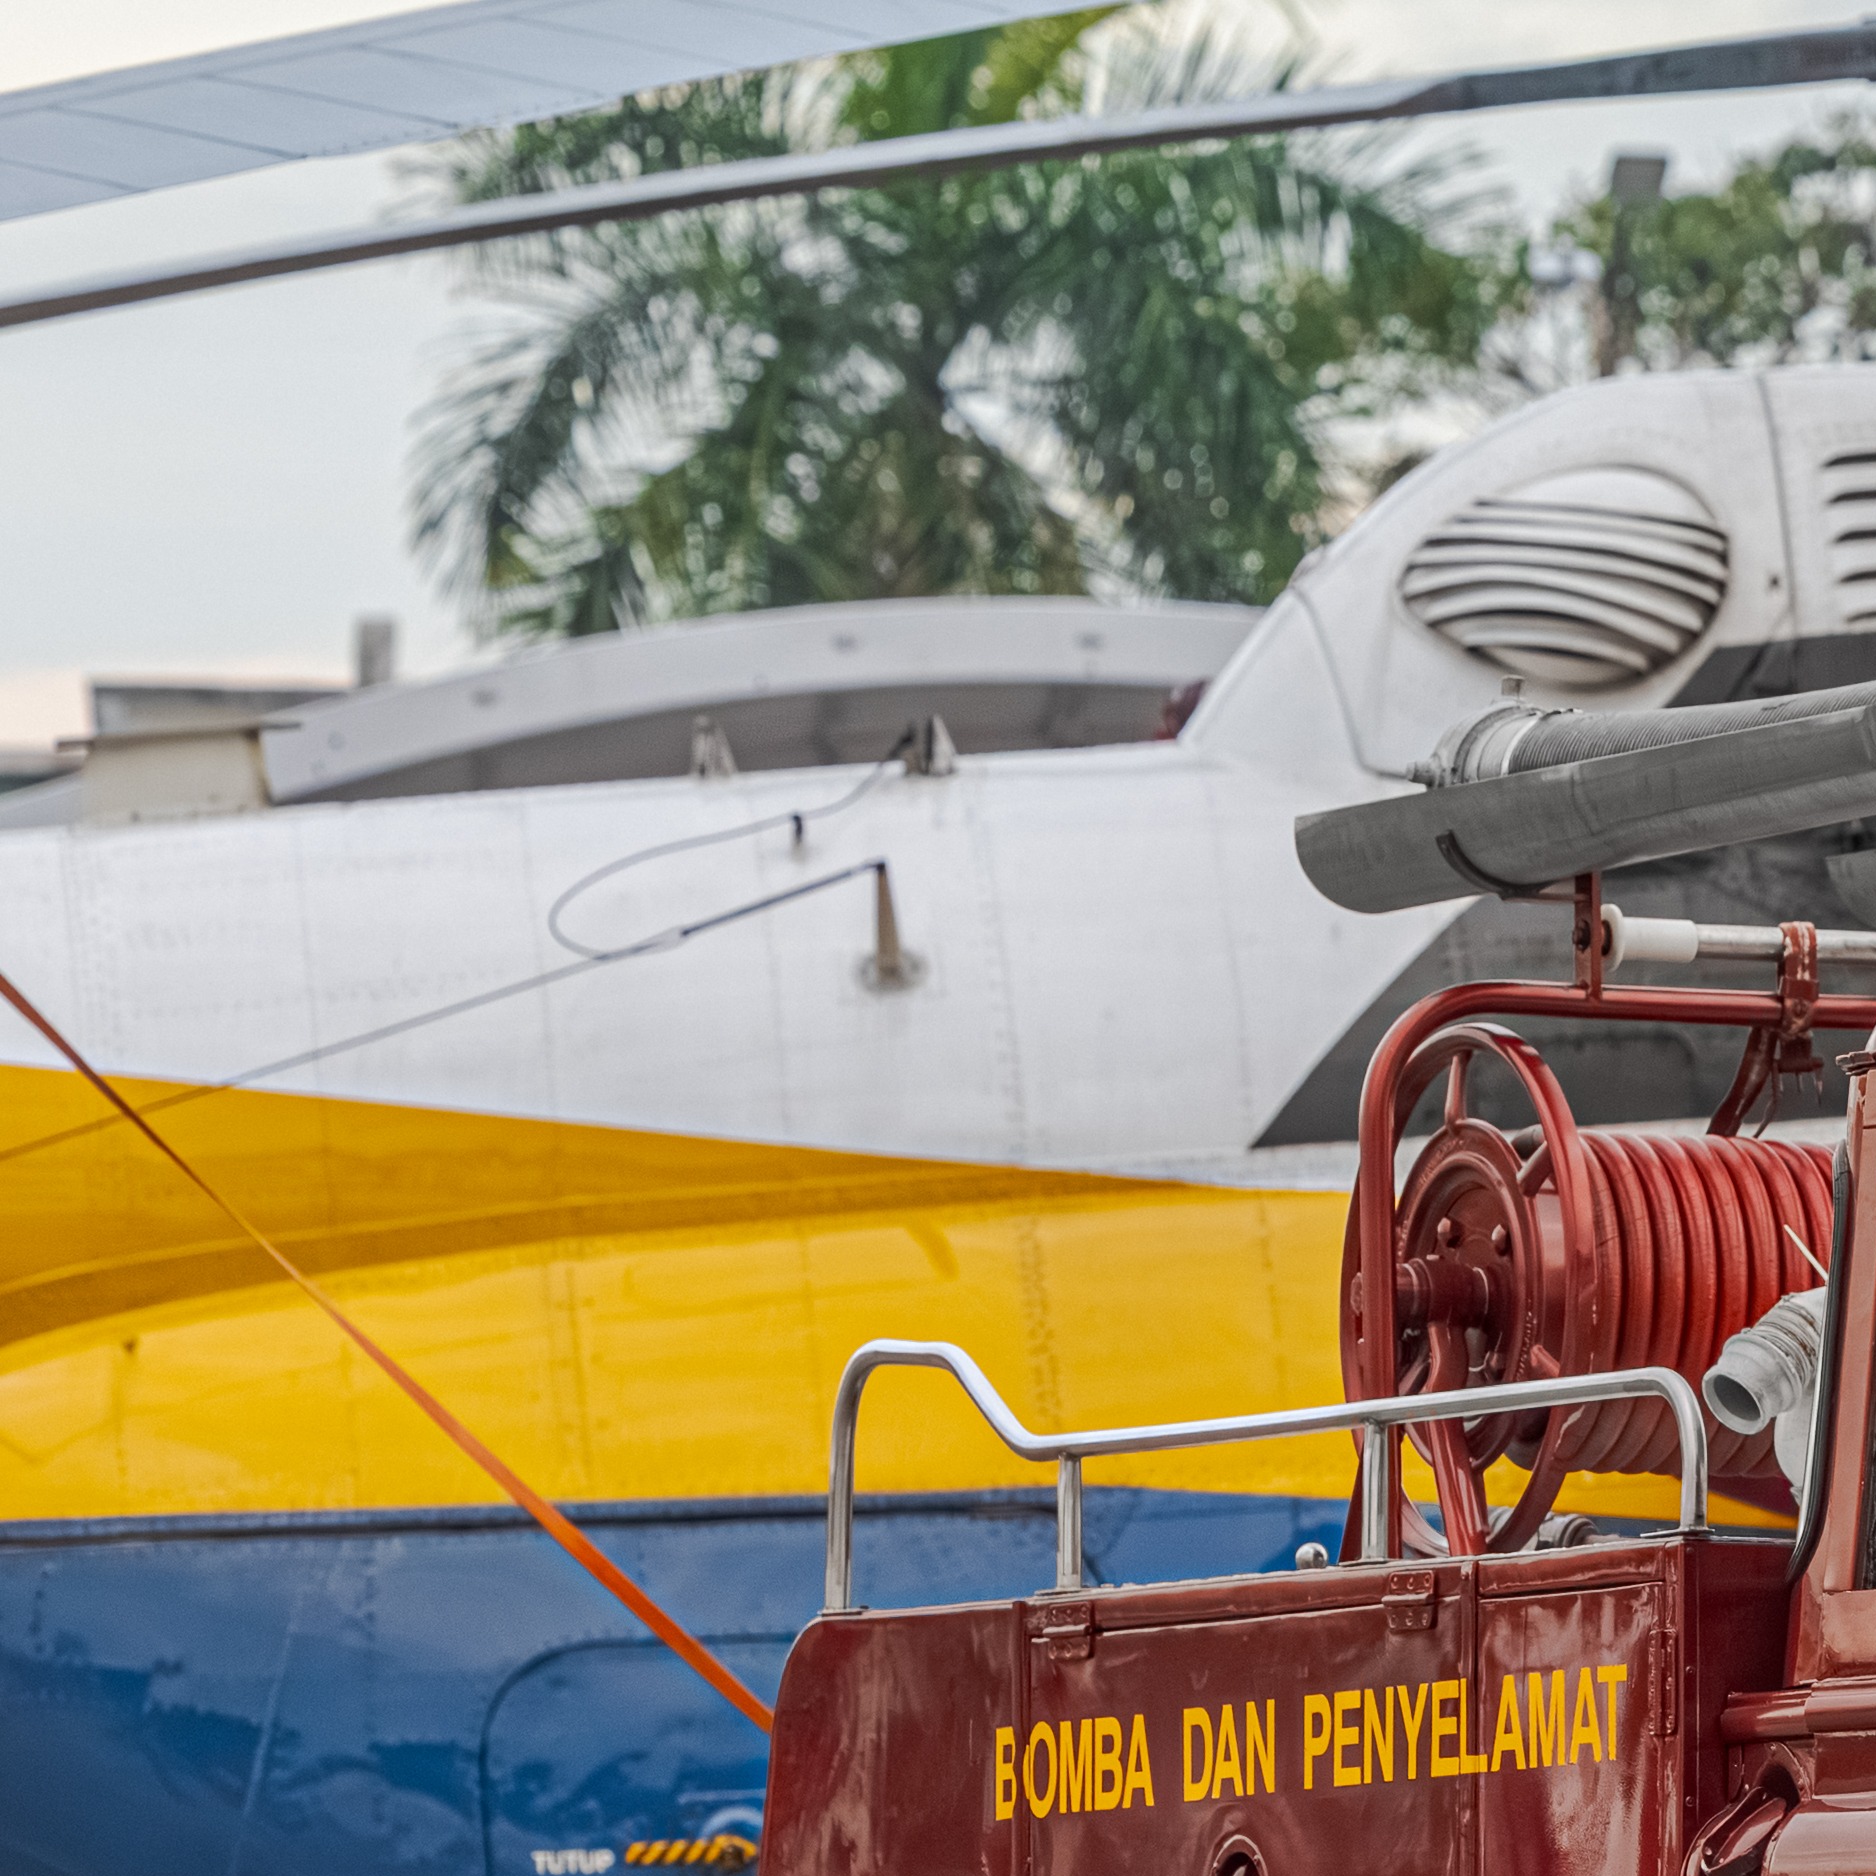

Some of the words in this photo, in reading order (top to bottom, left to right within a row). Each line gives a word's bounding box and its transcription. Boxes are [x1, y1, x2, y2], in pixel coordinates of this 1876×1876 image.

[995, 1714, 1154, 1822] BOMBA
[1183, 1698, 1275, 1802] DAN
[1304, 1664, 1628, 1790] PENYELAMAT
[530, 1848, 615, 1875] TUTUP
